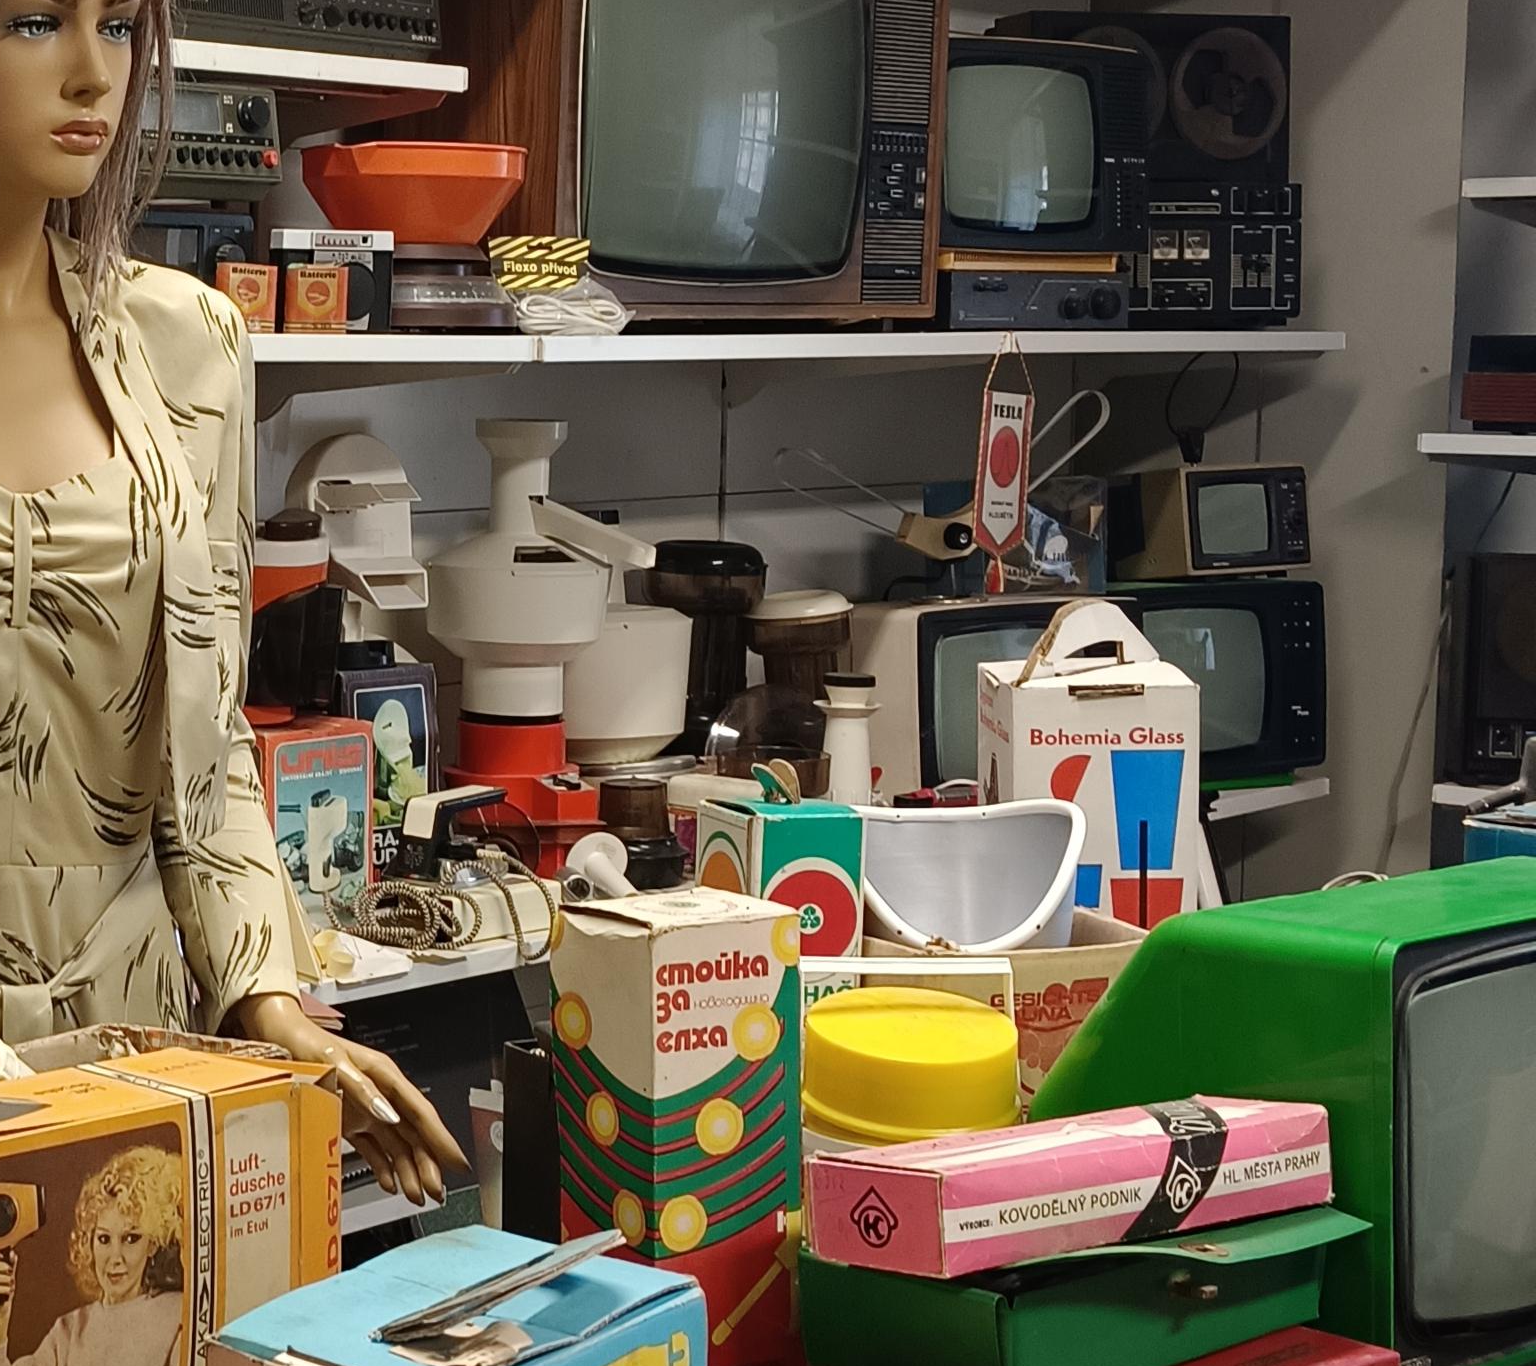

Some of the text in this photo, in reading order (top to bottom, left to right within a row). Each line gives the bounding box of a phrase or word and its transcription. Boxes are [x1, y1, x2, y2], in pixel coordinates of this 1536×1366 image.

[503, 260, 578, 276] Flexo přívod
[993, 403, 1023, 421] TESLA
[1029, 727, 1122, 747] Bohemia
[1128, 726, 1185, 746] Glass
[655, 949, 769, 987] стойка
[655, 989, 691, 1024] за
[655, 1023, 729, 1054] елха
[229, 1152, 267, 1176] Luft-
[1243, 1160, 1283, 1183] MĚSTA
[1284, 1151, 1322, 1174] PRAHY
[229, 1170, 286, 1197] dusche
[229, 1191, 286, 1219] LD 67/1
[998, 1186, 1142, 1226] KOVODĚLNÝ PODNIK
[229, 1218, 269, 1240] im Etui
